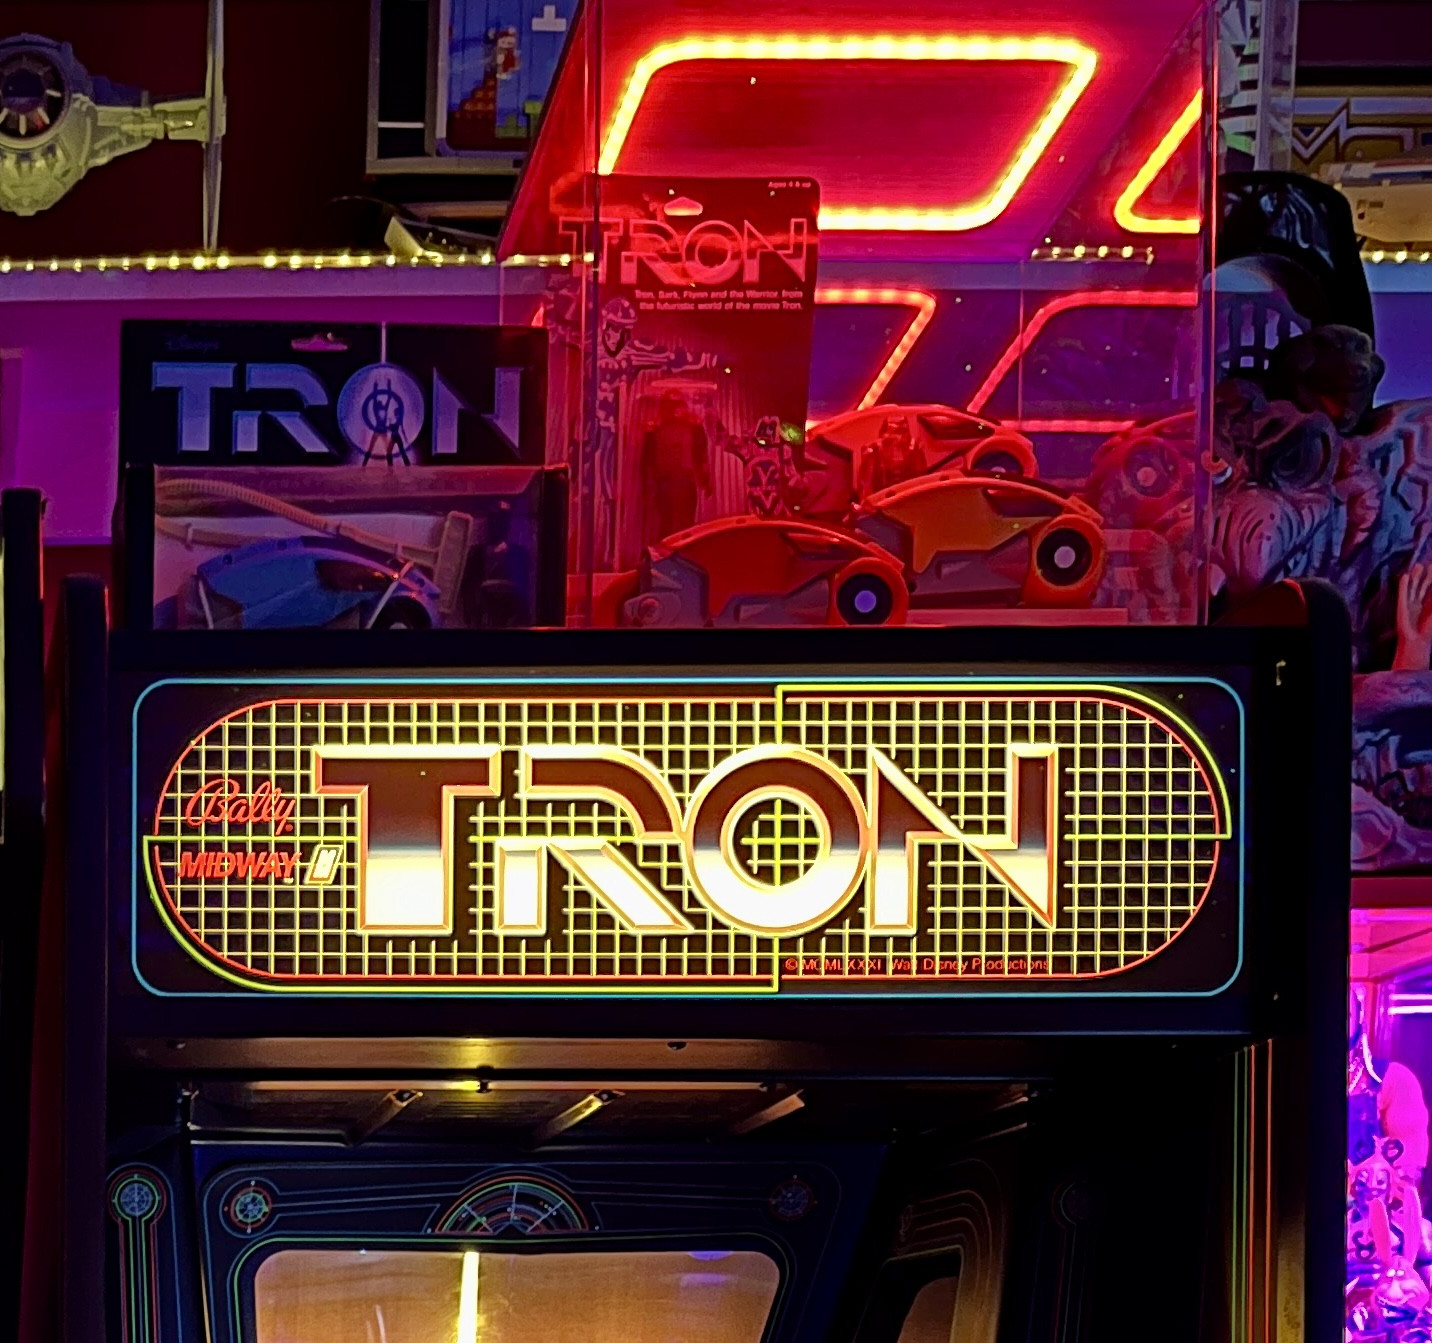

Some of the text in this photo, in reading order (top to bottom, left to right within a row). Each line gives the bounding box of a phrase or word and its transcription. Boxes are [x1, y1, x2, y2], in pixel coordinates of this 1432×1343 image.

[558, 216, 808, 286] TRON
[683, 290, 709, 299] Flynn
[710, 290, 728, 298] and
[729, 290, 745, 298] the
[781, 289, 804, 299] from
[735, 302, 751, 310] the
[151, 361, 525, 459] TRON
[185, 778, 297, 836] Bally
[313, 743, 1059, 937] TRON
[178, 851, 303, 879] MIDWAY
[924, 957, 968, 973] Dsney
[972, 957, 1050, 970] Poductons
